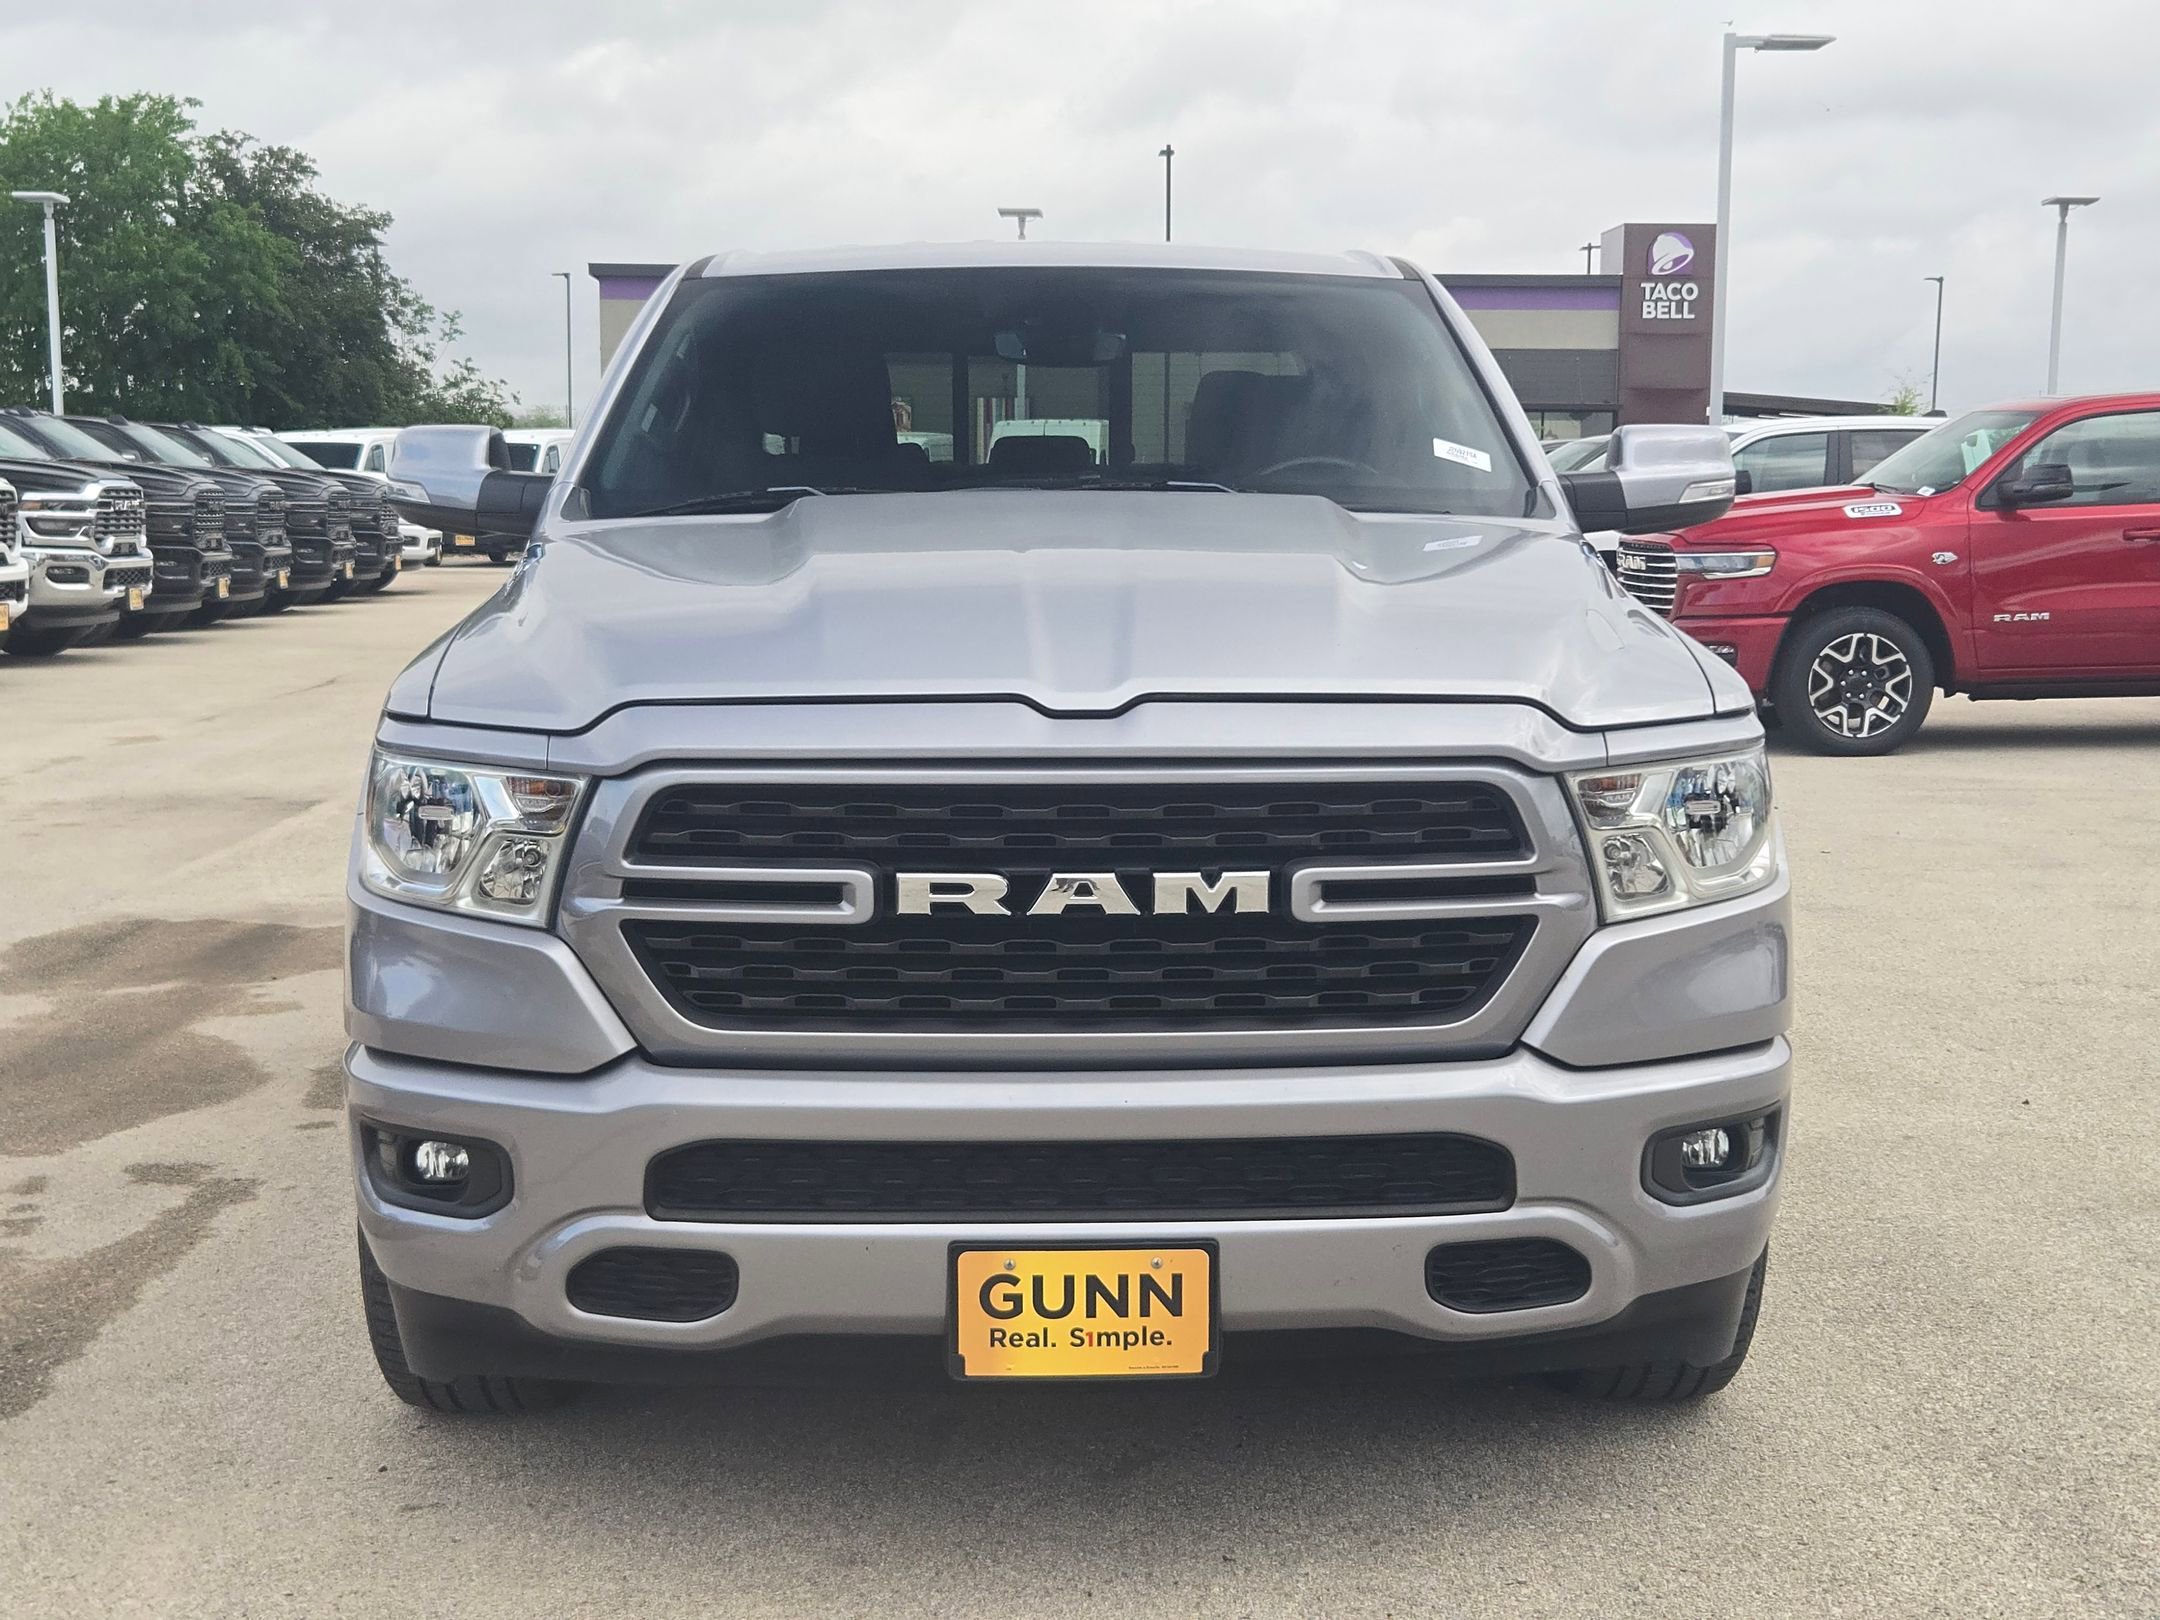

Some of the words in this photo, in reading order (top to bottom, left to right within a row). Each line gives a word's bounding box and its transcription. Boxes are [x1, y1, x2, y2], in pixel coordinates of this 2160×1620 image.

[1640, 282, 1699, 301] TACO
[1642, 301, 1695, 319] BELL
[1993, 612, 2050, 622] RAM
[896, 871, 1271, 915] RAM
[978, 1272, 1183, 1320] GUNN
[989, 1327, 1057, 1348] Real.
